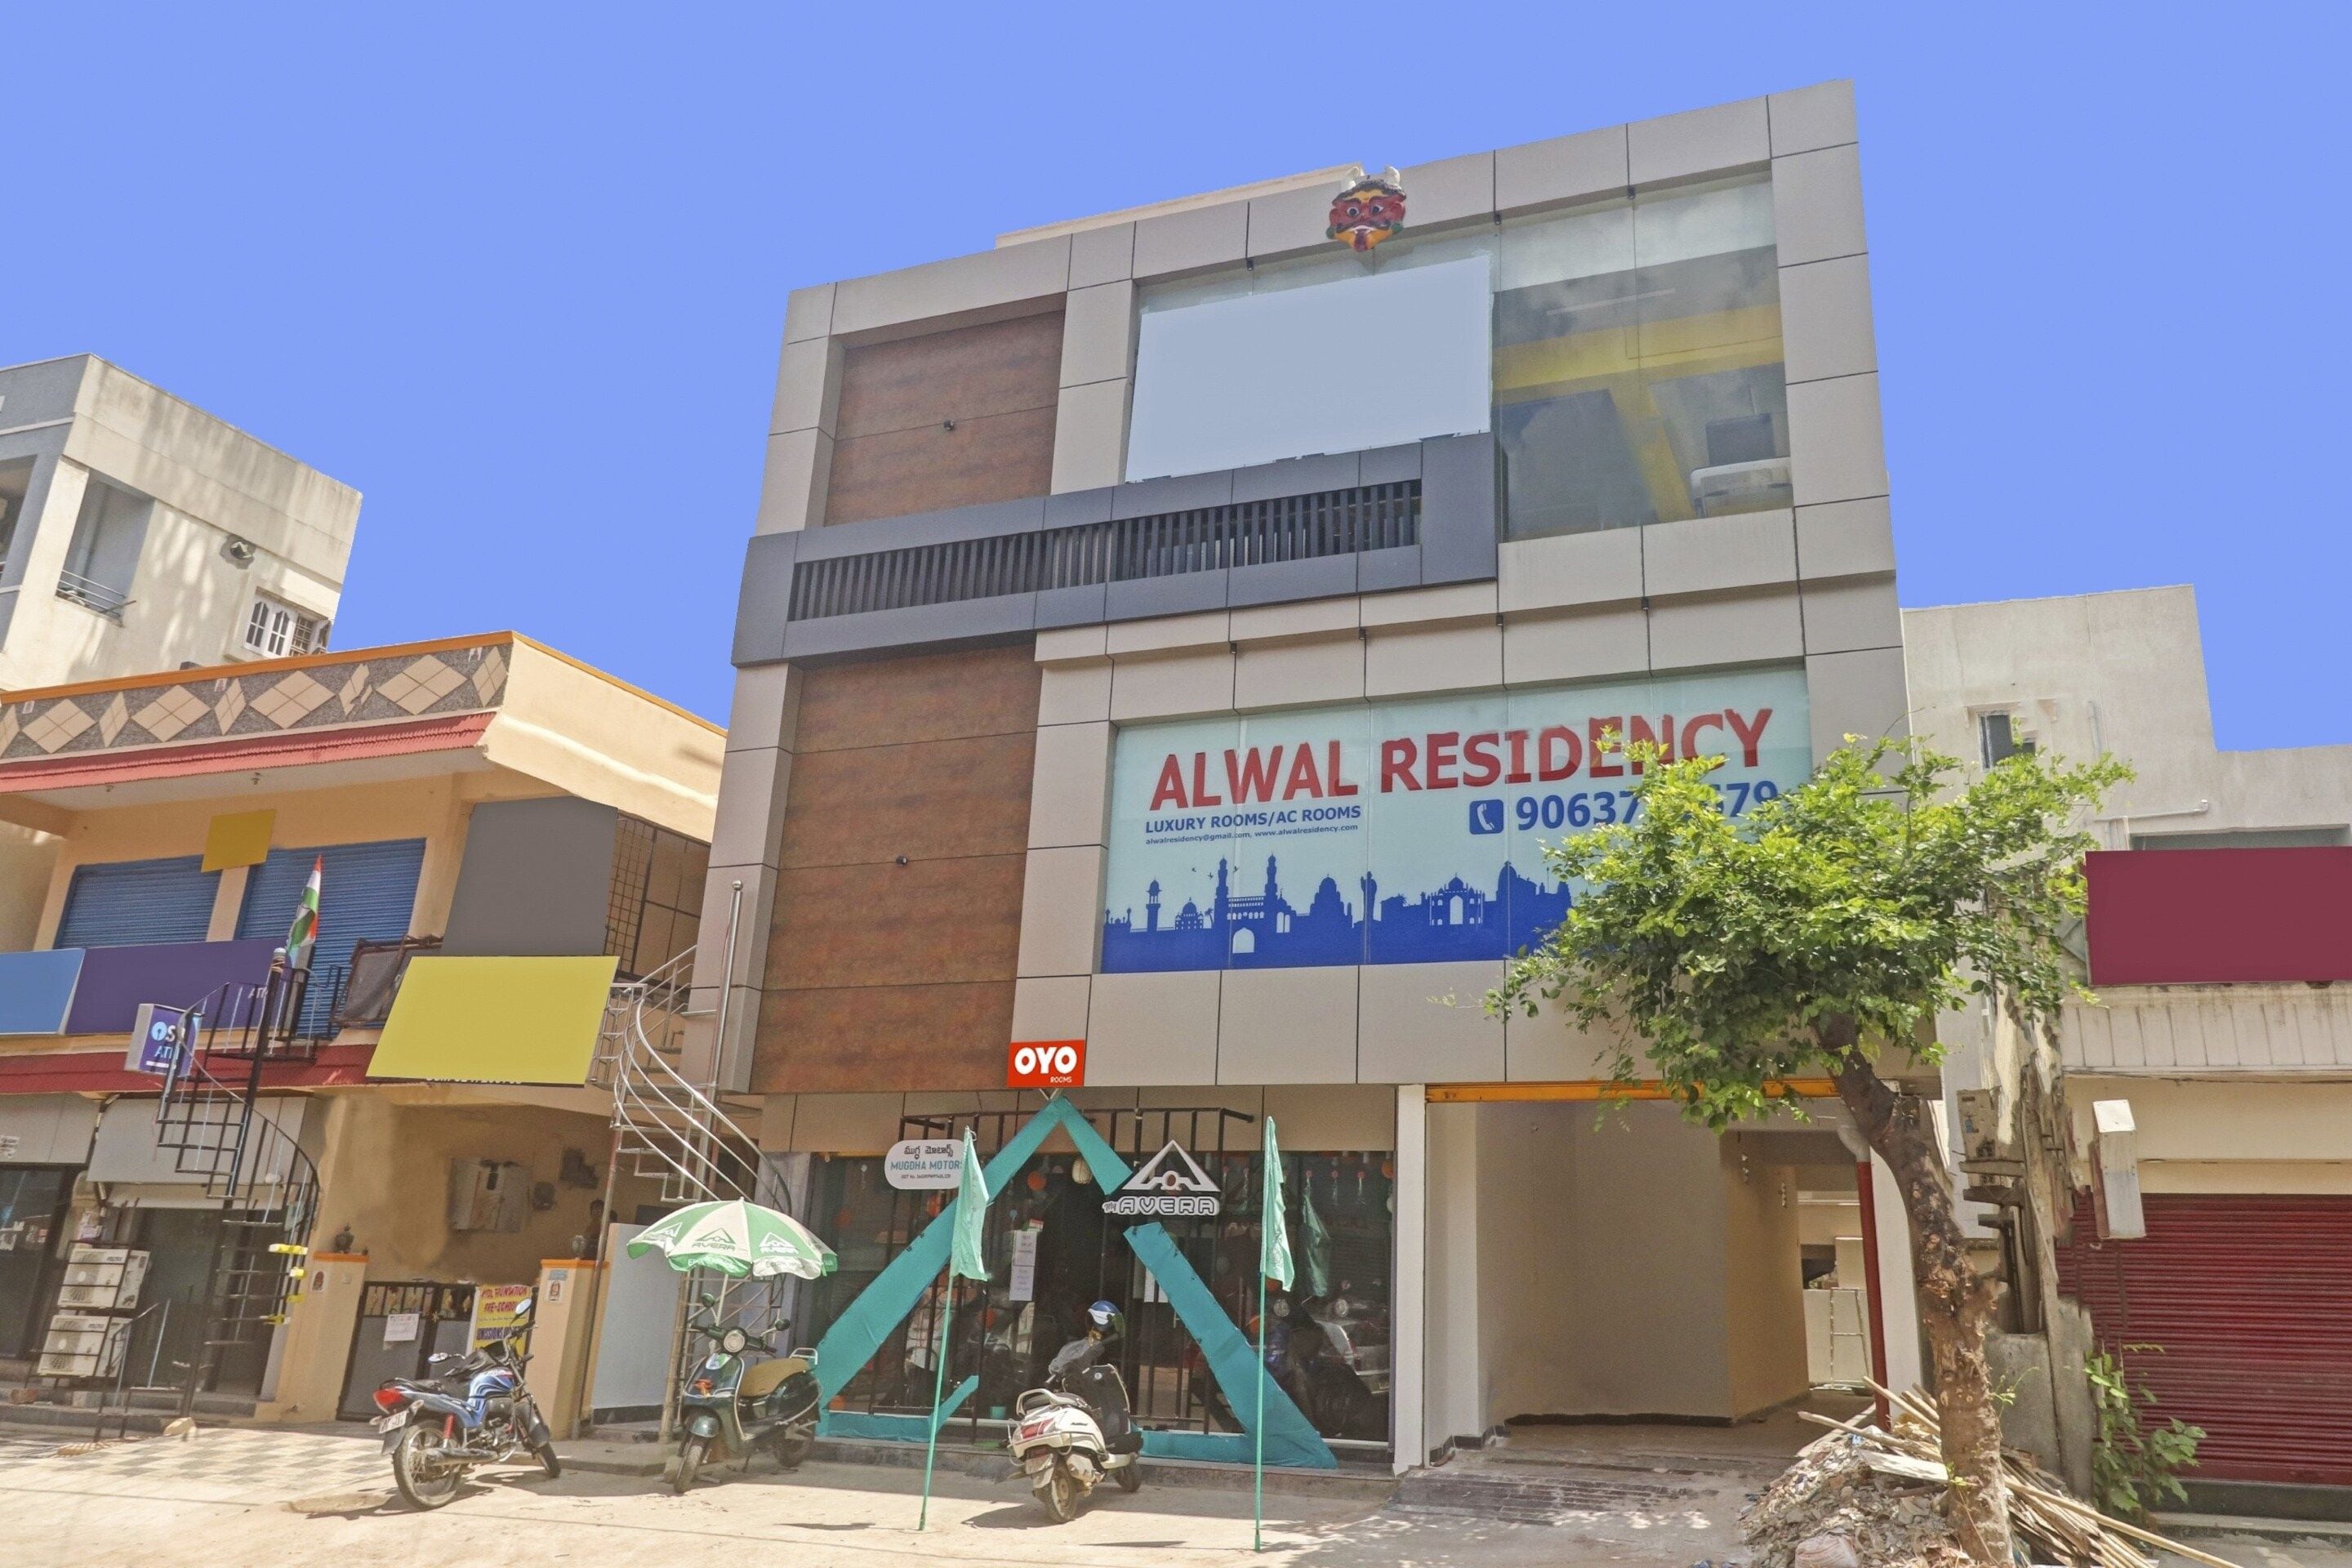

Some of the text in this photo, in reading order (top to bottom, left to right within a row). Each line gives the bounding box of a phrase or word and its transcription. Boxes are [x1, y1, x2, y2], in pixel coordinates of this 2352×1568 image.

[1150, 708, 1774, 811] ALWAL RESIDENCY
[1145, 817, 1206, 833] LUXURY
[1302, 805, 1361, 822] ROOMS
[1254, 824, 1358, 838] www.alwalresidency.com
[1014, 1045, 1077, 1075] OYO
[1050, 1076, 1072, 1084] ROOMS
[890, 1160, 927, 1170] MUGDHA
[1118, 1196, 1218, 1215] AVERA
